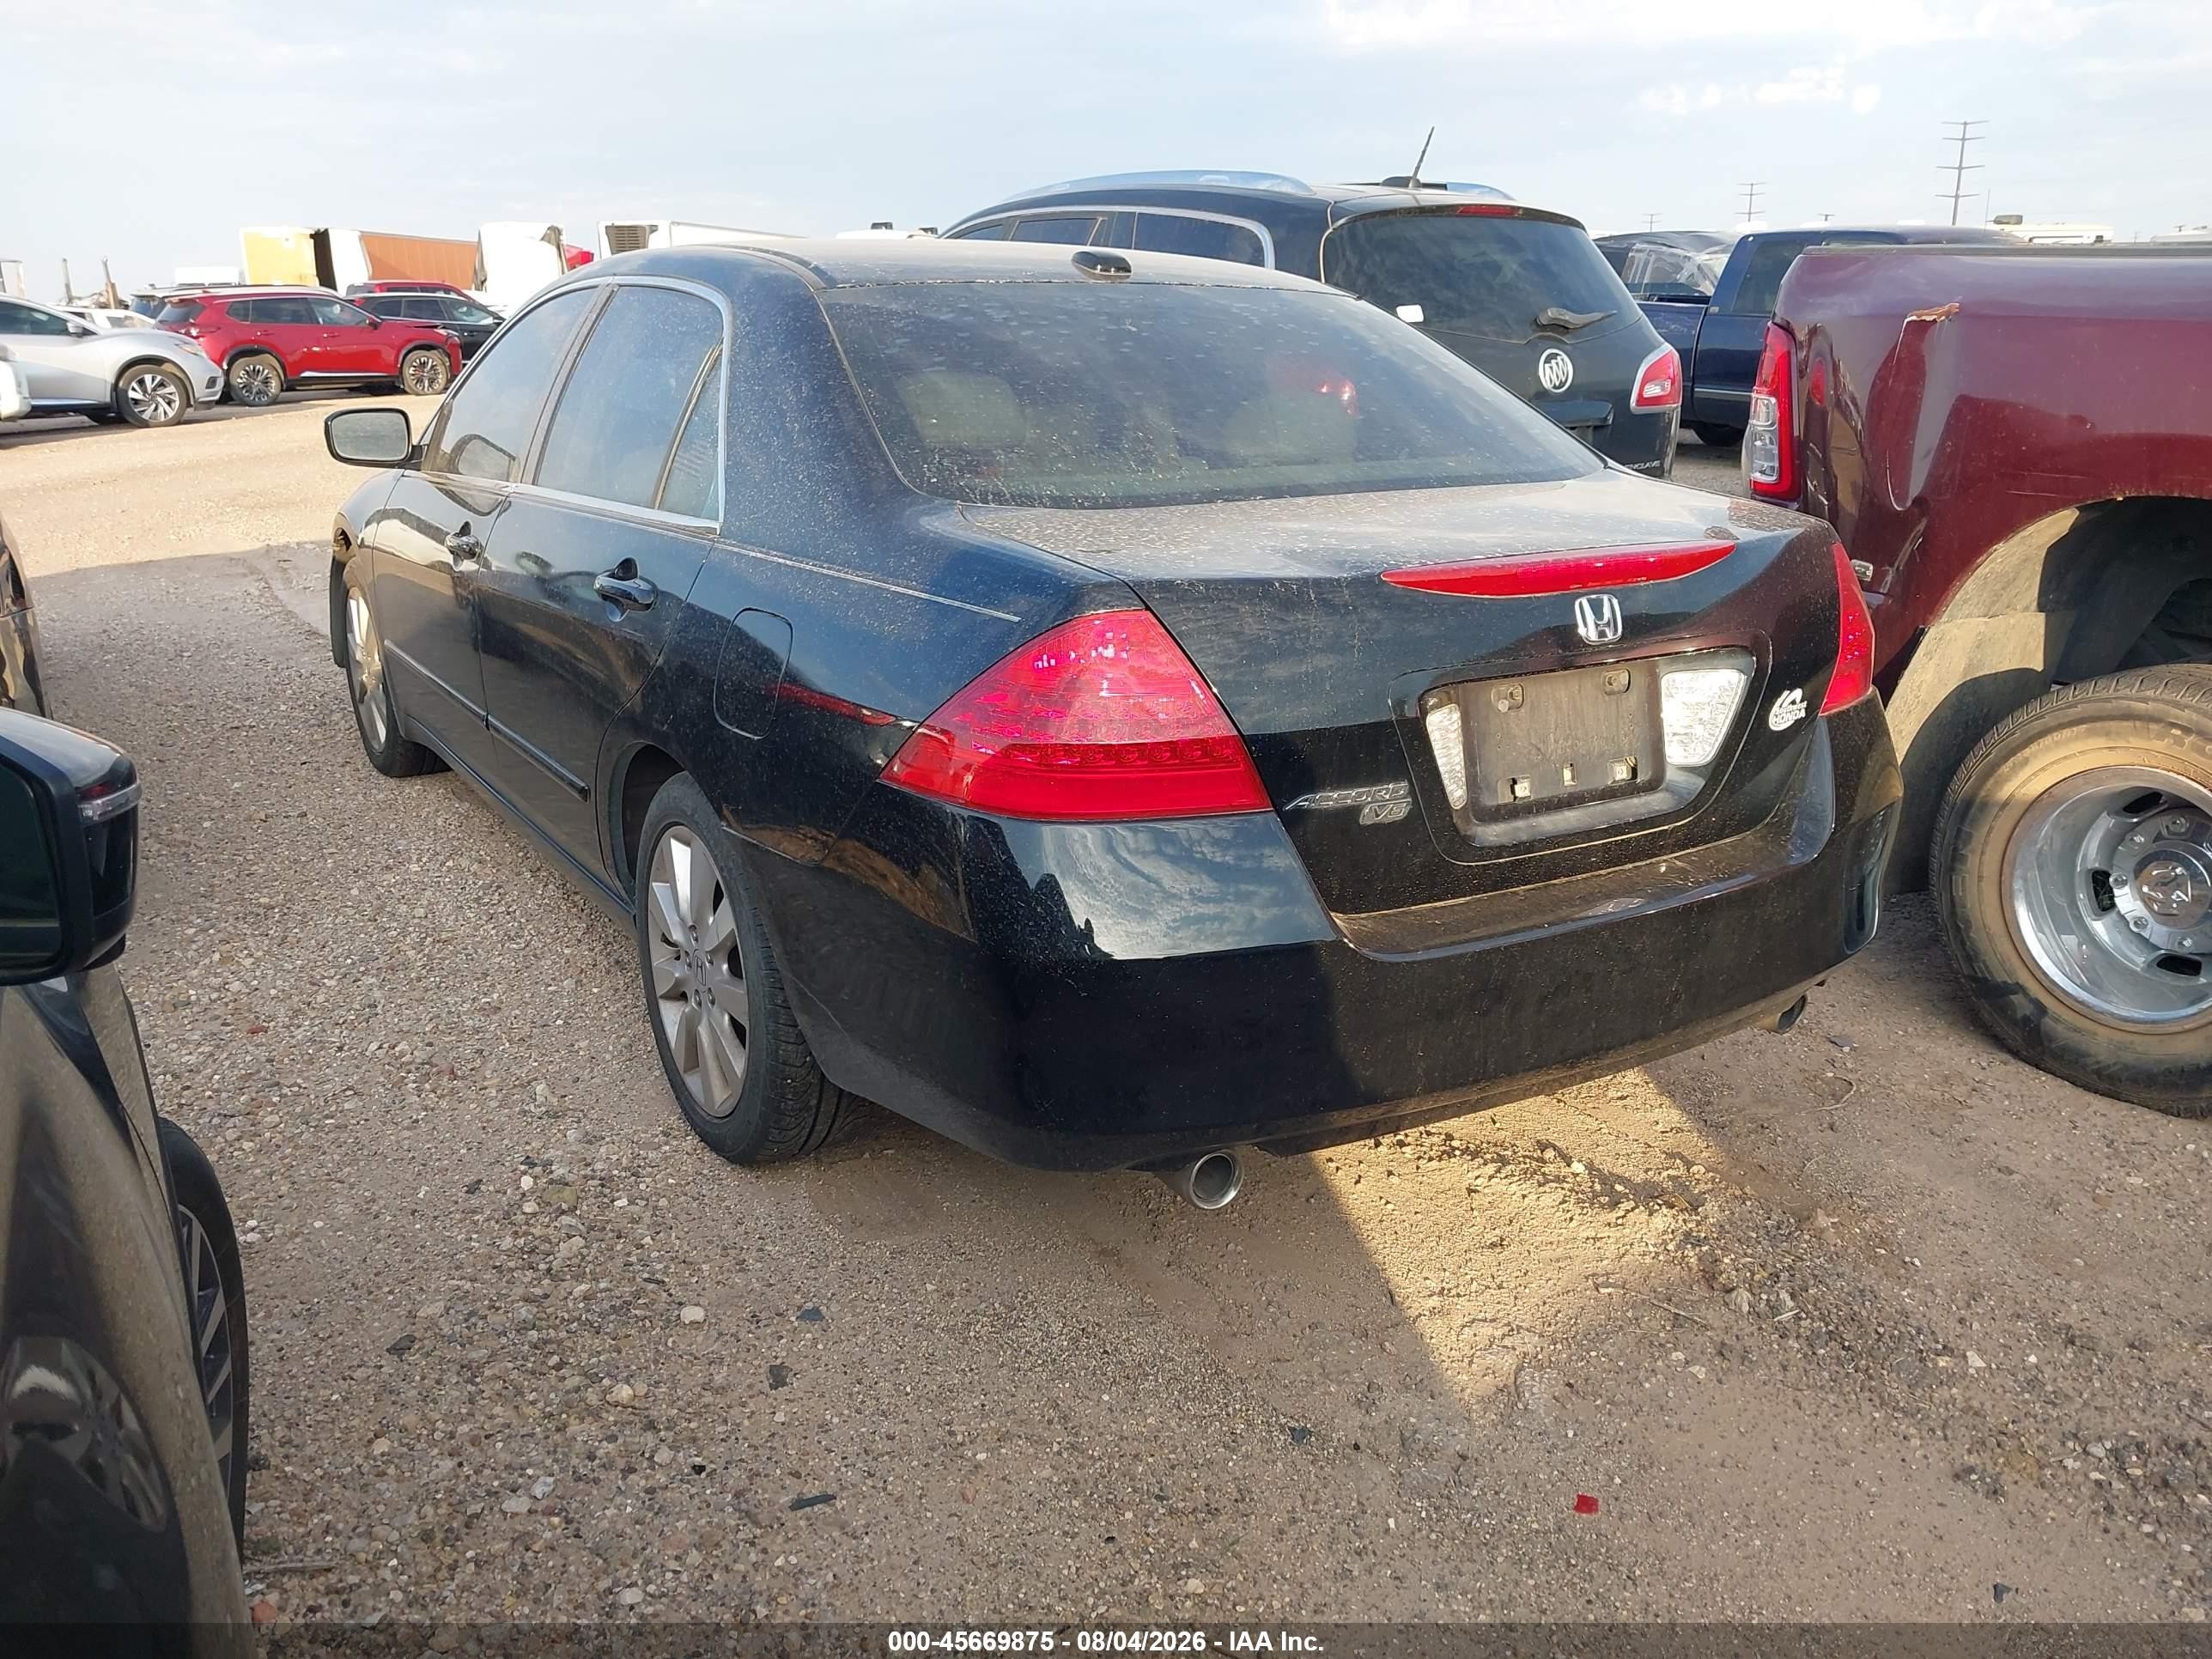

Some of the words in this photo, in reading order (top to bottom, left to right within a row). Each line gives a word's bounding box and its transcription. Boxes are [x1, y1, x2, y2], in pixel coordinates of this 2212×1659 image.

[1772, 708, 1806, 726] HONDA
[1283, 781, 1409, 811] ACCORD
[1368, 801, 1410, 822] V6
